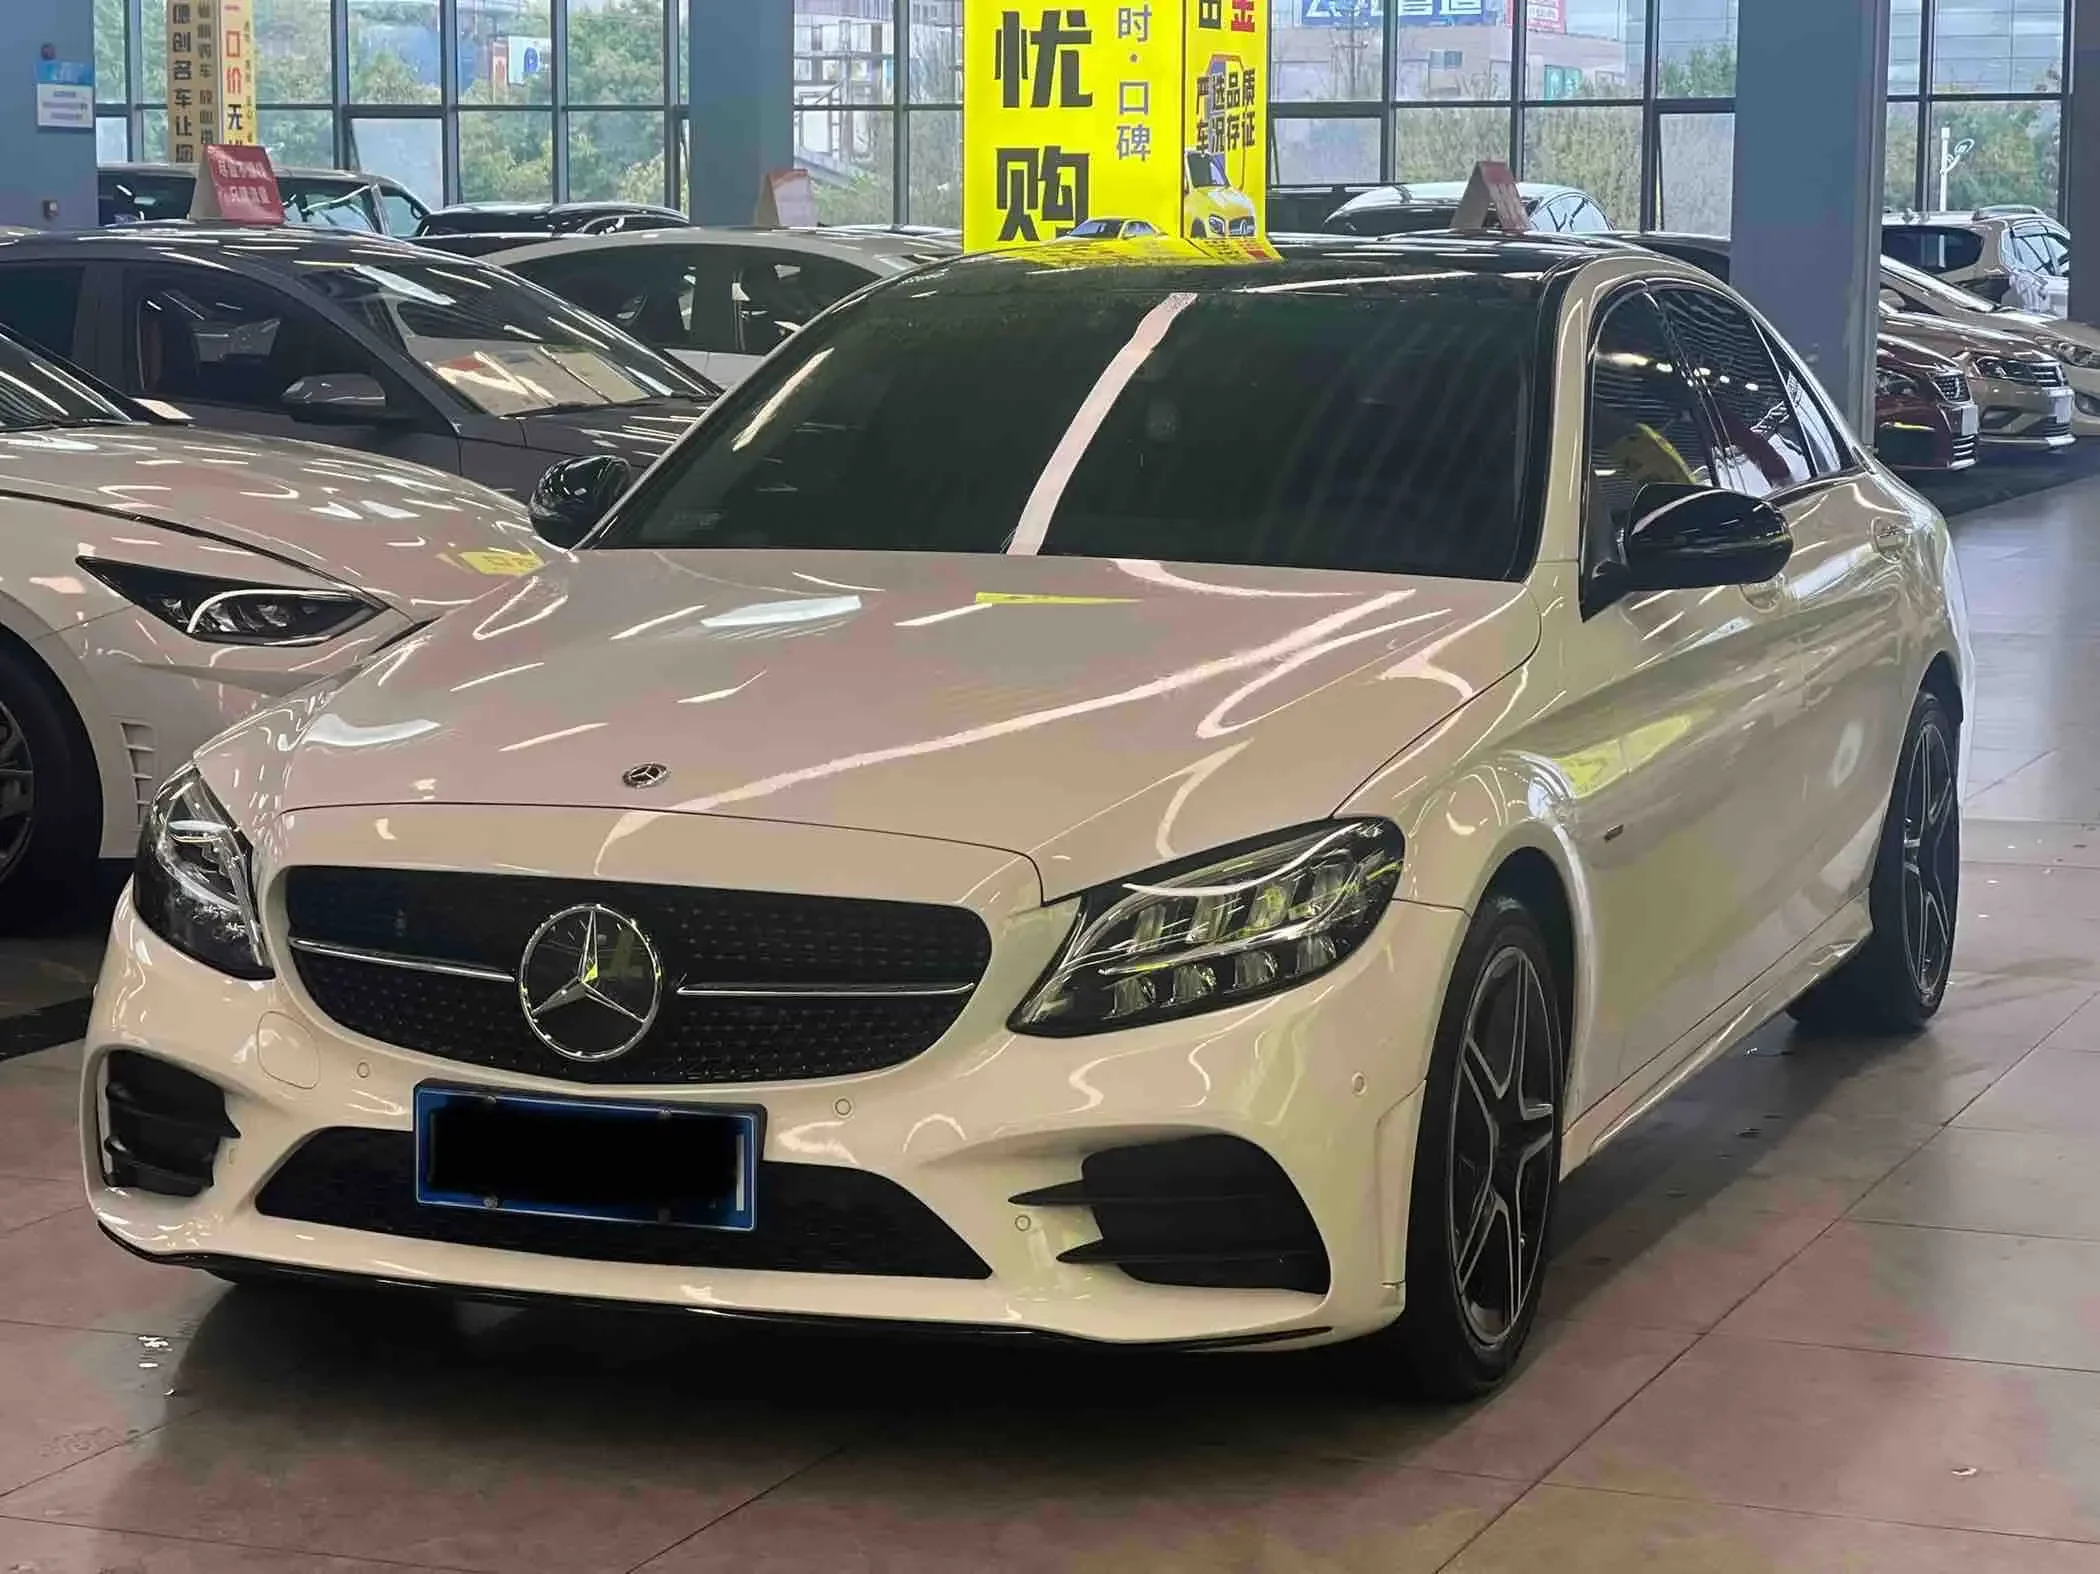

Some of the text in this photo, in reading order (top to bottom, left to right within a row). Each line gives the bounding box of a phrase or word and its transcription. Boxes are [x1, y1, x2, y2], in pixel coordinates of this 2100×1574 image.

[224, 4, 243, 145] 一口价无
[1196, 68, 1256, 115] 严选品质
[995, 10, 1093, 242] 忧购
[1196, 111, 1256, 154] 车况存证
